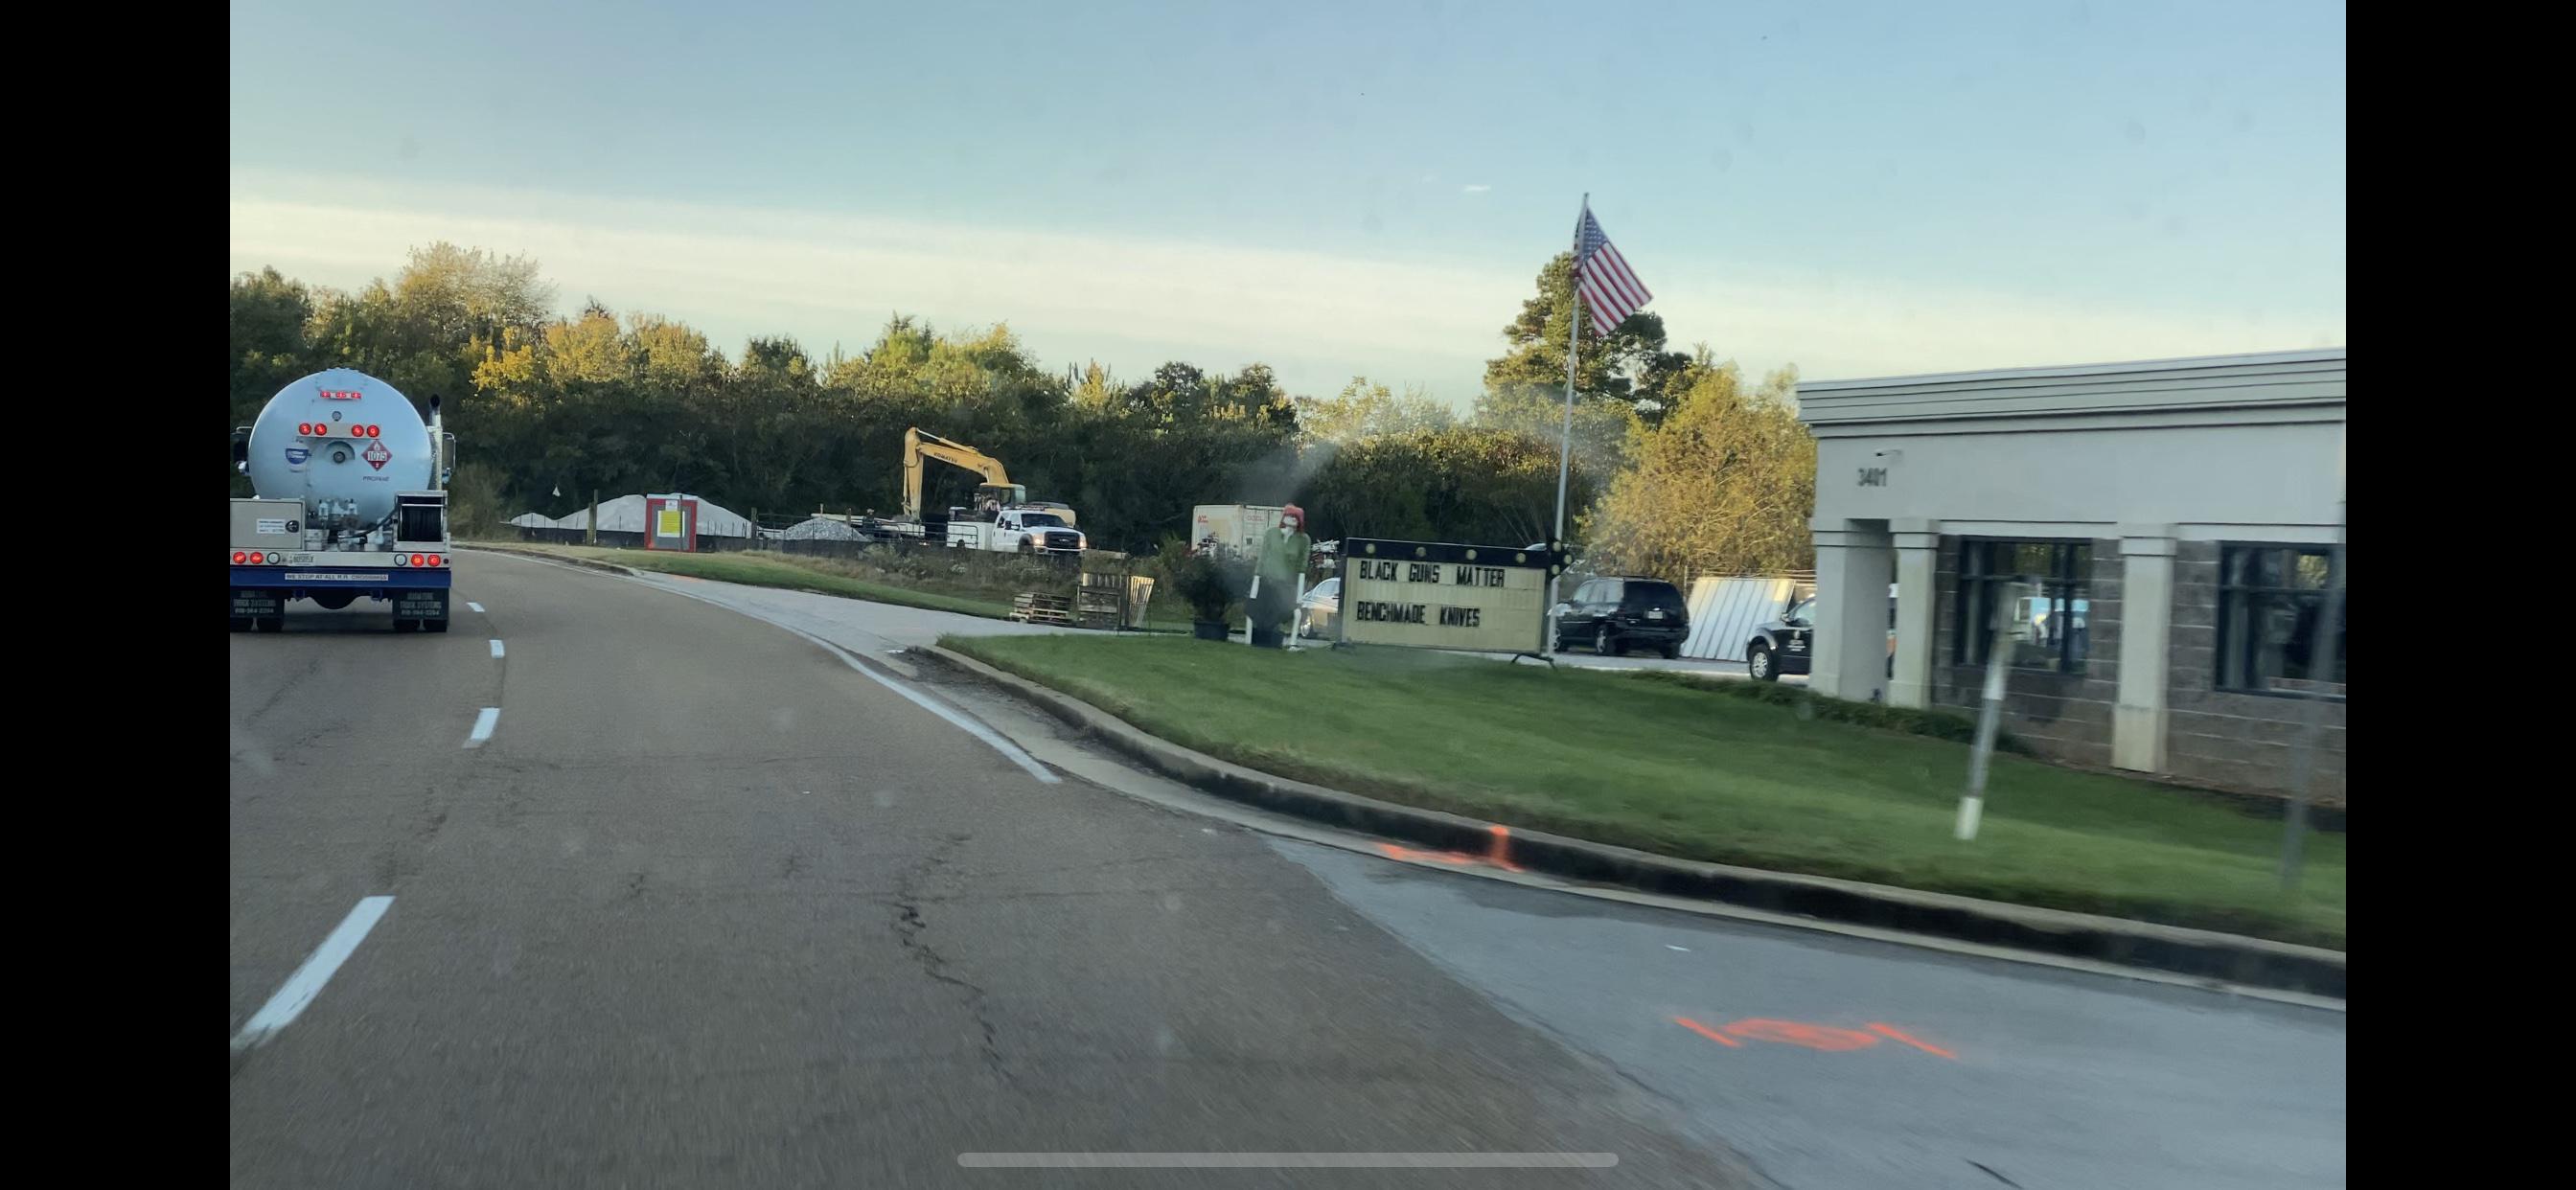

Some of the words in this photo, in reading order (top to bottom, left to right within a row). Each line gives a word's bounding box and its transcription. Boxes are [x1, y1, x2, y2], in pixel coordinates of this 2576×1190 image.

[368, 451, 387, 461] 1075
[1857, 467, 1887, 487] 3401
[1359, 561, 1399, 582] BLACK
[1409, 562, 1441, 584] GUNS
[1456, 565, 1506, 587] MATTER
[1356, 601, 1426, 624] BENCHMADE
[1439, 606, 1481, 628] KNIVES
